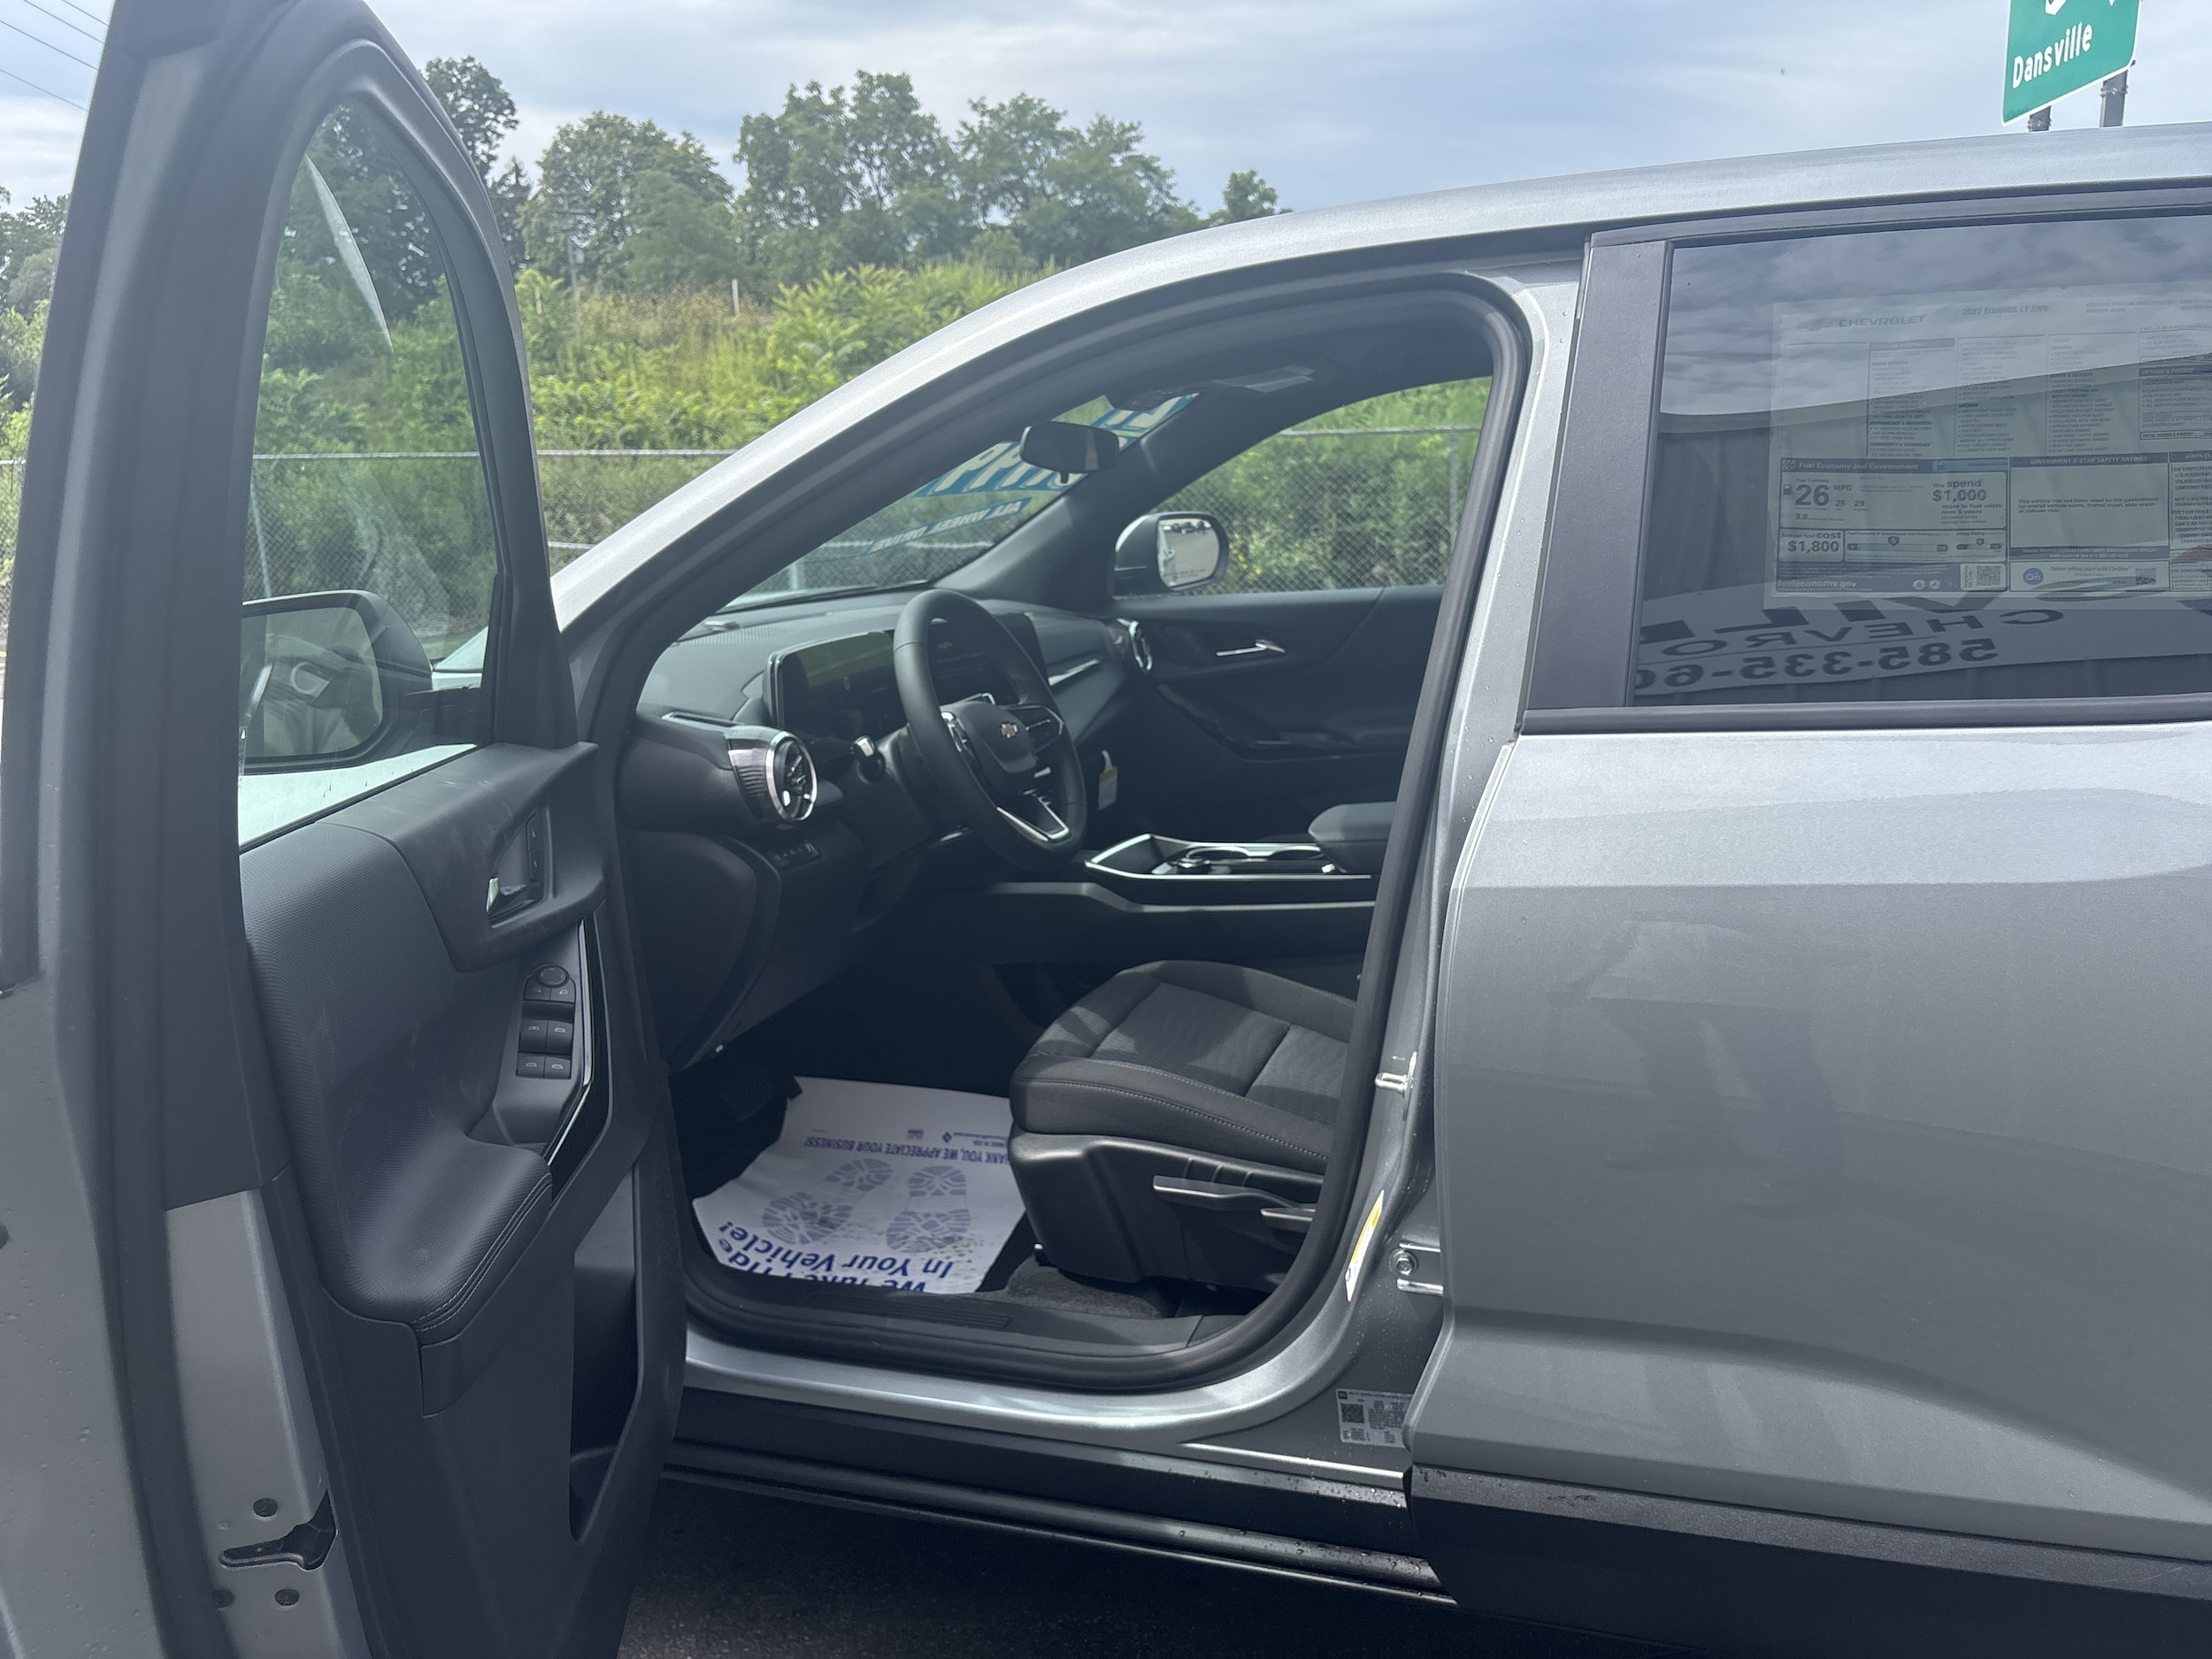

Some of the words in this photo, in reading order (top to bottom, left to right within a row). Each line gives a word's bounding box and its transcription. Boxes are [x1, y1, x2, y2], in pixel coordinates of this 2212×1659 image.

[2012, 21, 2093, 88] Dansville
[1984, 305, 2018, 315] EQUINOX
[1838, 314, 1925, 327] CHEVROLET
[1816, 462, 1851, 471] Economy
[1946, 479, 1982, 489] spend
[1794, 484, 1830, 506] 26
[1932, 488, 1986, 503] $1,000
[1787, 540, 1839, 554] $1,800
[1778, 580, 1857, 589] fueleconomy.gov
[803, 1136, 856, 1152] BUSINESS!
[856, 1140, 884, 1154] YOUR
[885, 1142, 941, 1158] APPRECIATE
[942, 1148, 959, 1161] WE
[960, 1148, 983, 1163] YOU,
[718, 1221, 836, 1273] Vehicle!
[841, 1254, 911, 1278] Your
[921, 1256, 956, 1279] In
